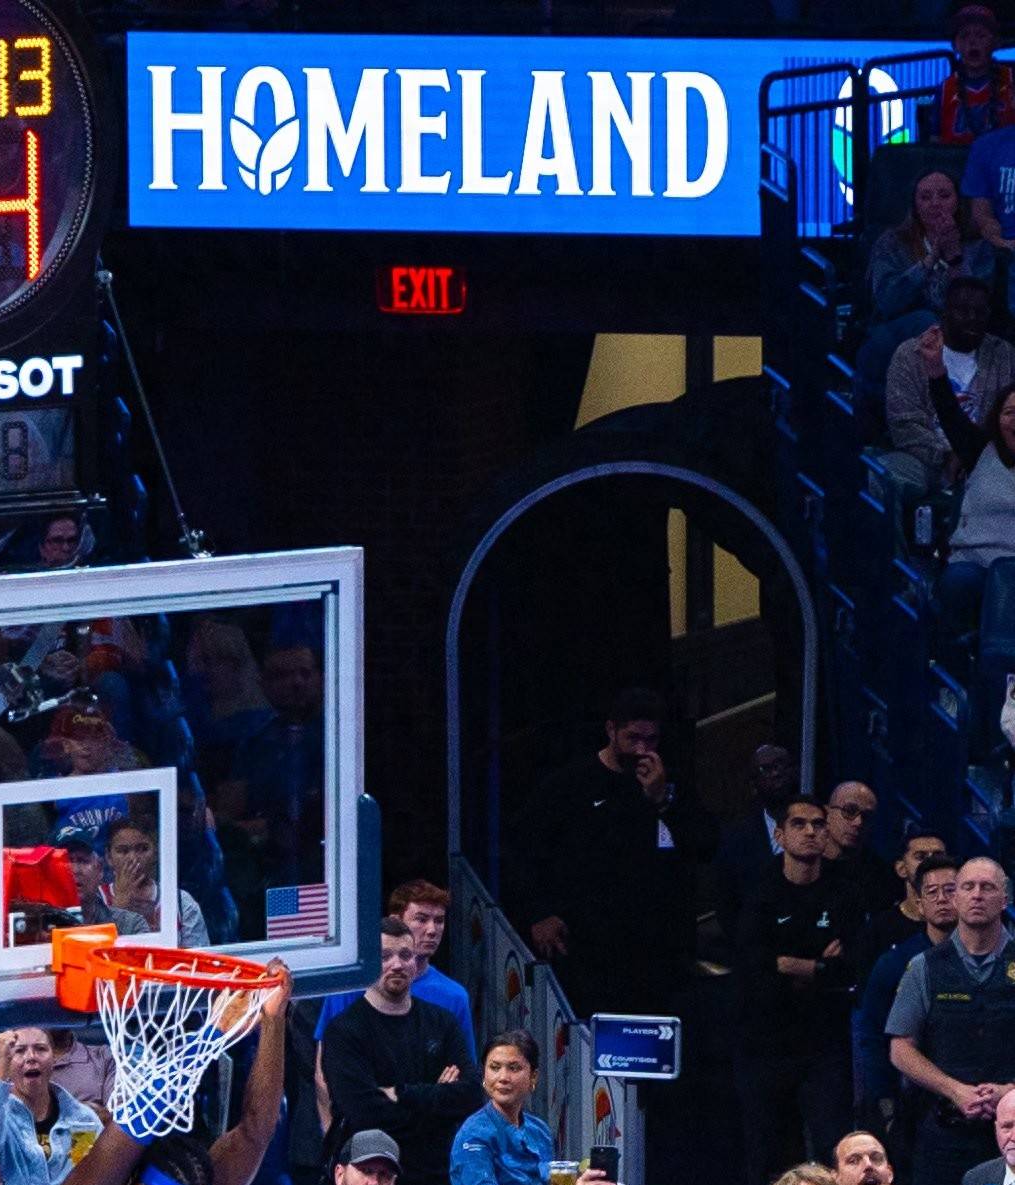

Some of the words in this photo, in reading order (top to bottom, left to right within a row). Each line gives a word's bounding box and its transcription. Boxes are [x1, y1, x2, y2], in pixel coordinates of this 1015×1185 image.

[147, 65, 729, 198] HOMELAND
[392, 266, 452, 310] EXIT
[622, 1026, 660, 1036] PLAYERS
